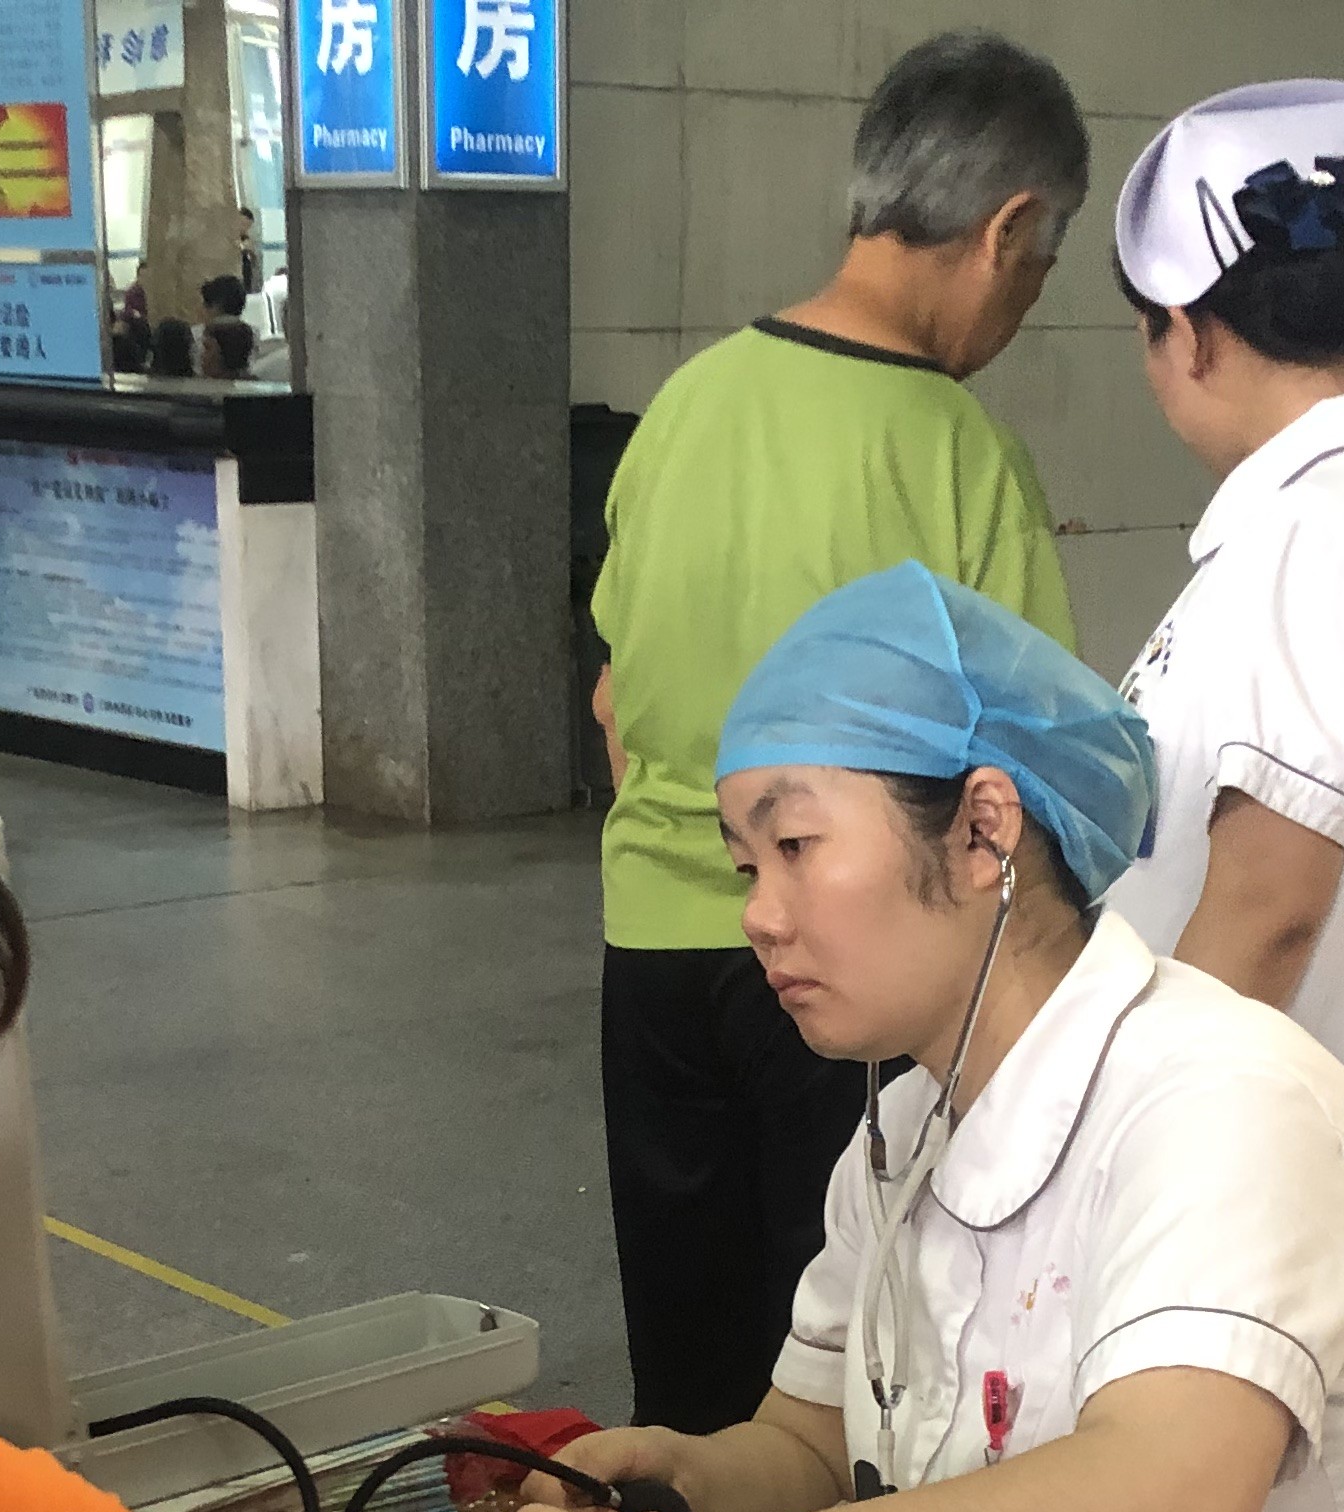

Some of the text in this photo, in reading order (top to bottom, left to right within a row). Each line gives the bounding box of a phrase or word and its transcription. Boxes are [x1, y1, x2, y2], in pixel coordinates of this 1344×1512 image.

[317, 0, 378, 76] 房
[456, 0, 535, 81] 房
[313, 124, 387, 151] Pharmacy
[451, 126, 545, 159] Pharmacy
